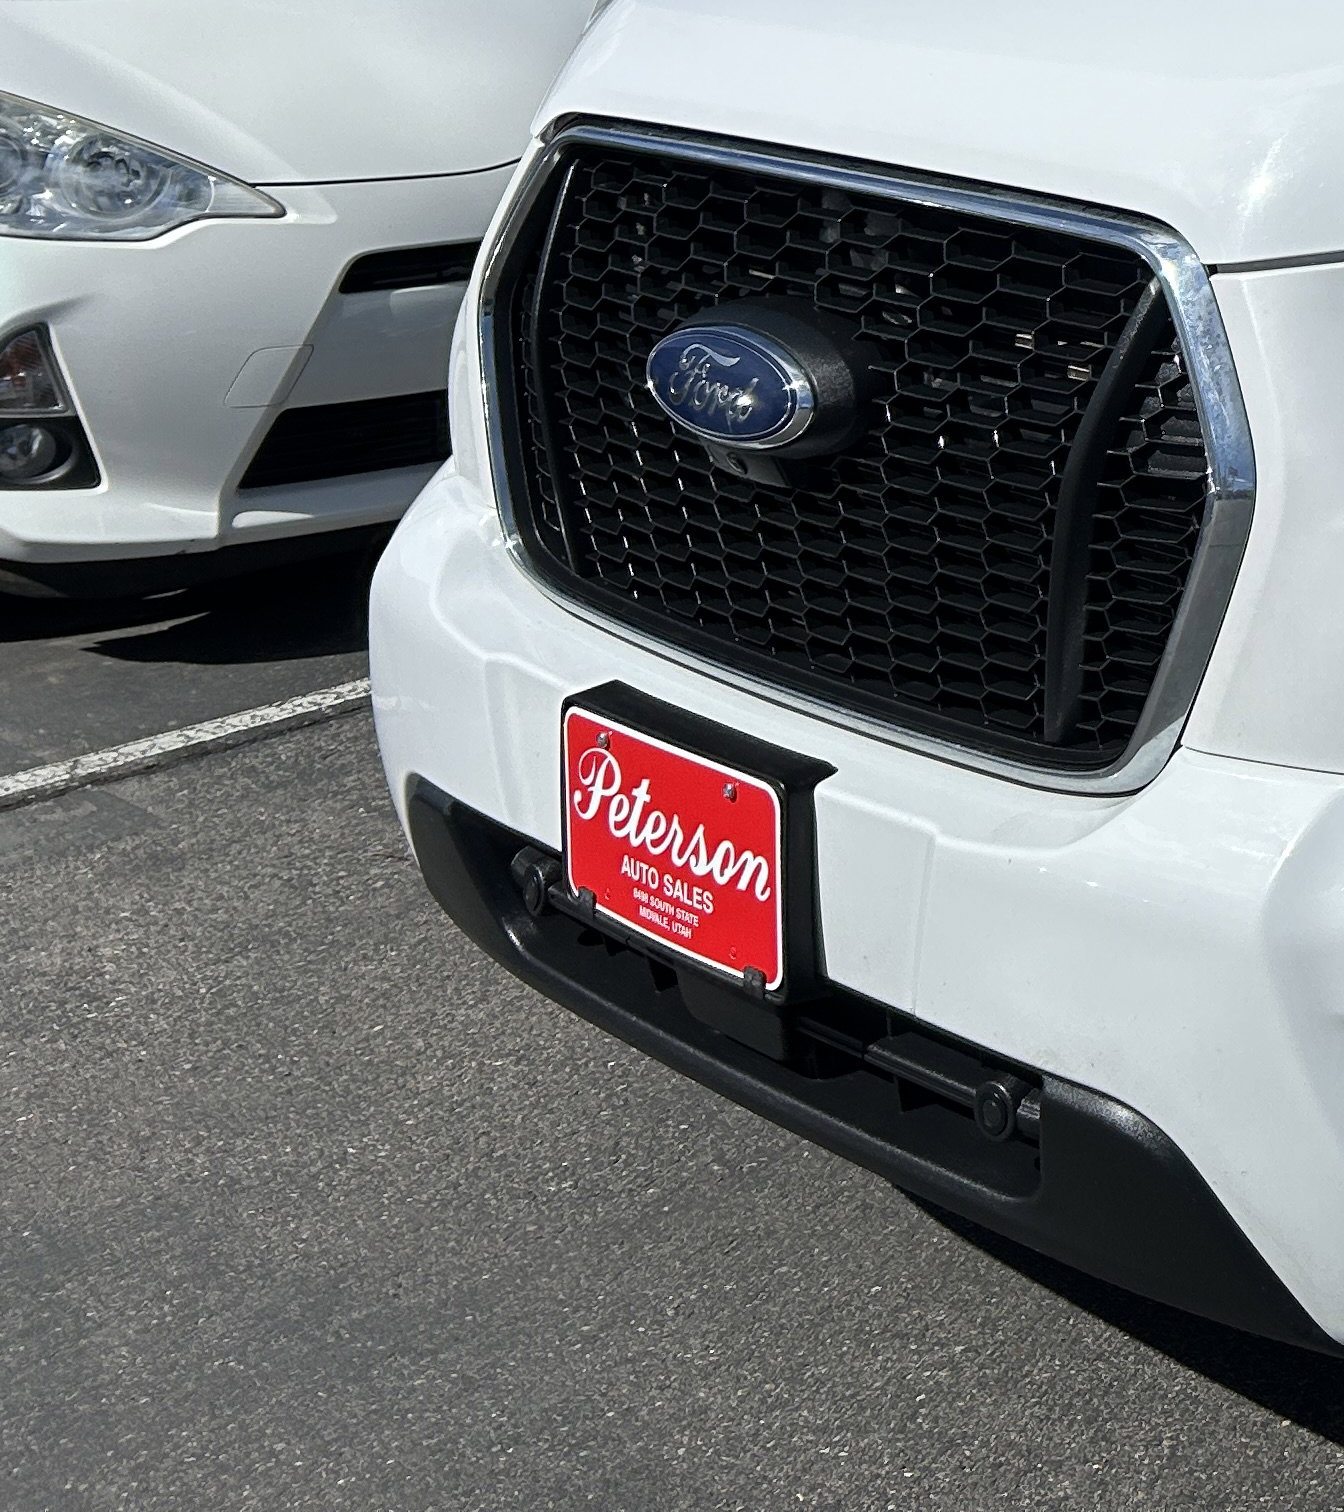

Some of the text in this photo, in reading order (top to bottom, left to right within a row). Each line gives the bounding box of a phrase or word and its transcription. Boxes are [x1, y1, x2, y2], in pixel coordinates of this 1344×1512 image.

[669, 344, 759, 424] Ford
[574, 748, 770, 902] Peterson
[621, 854, 714, 914] AUTO SALES
[650, 895, 674, 916] SOUTH
[675, 907, 699, 927] STATE
[671, 920, 692, 940] UTAH
